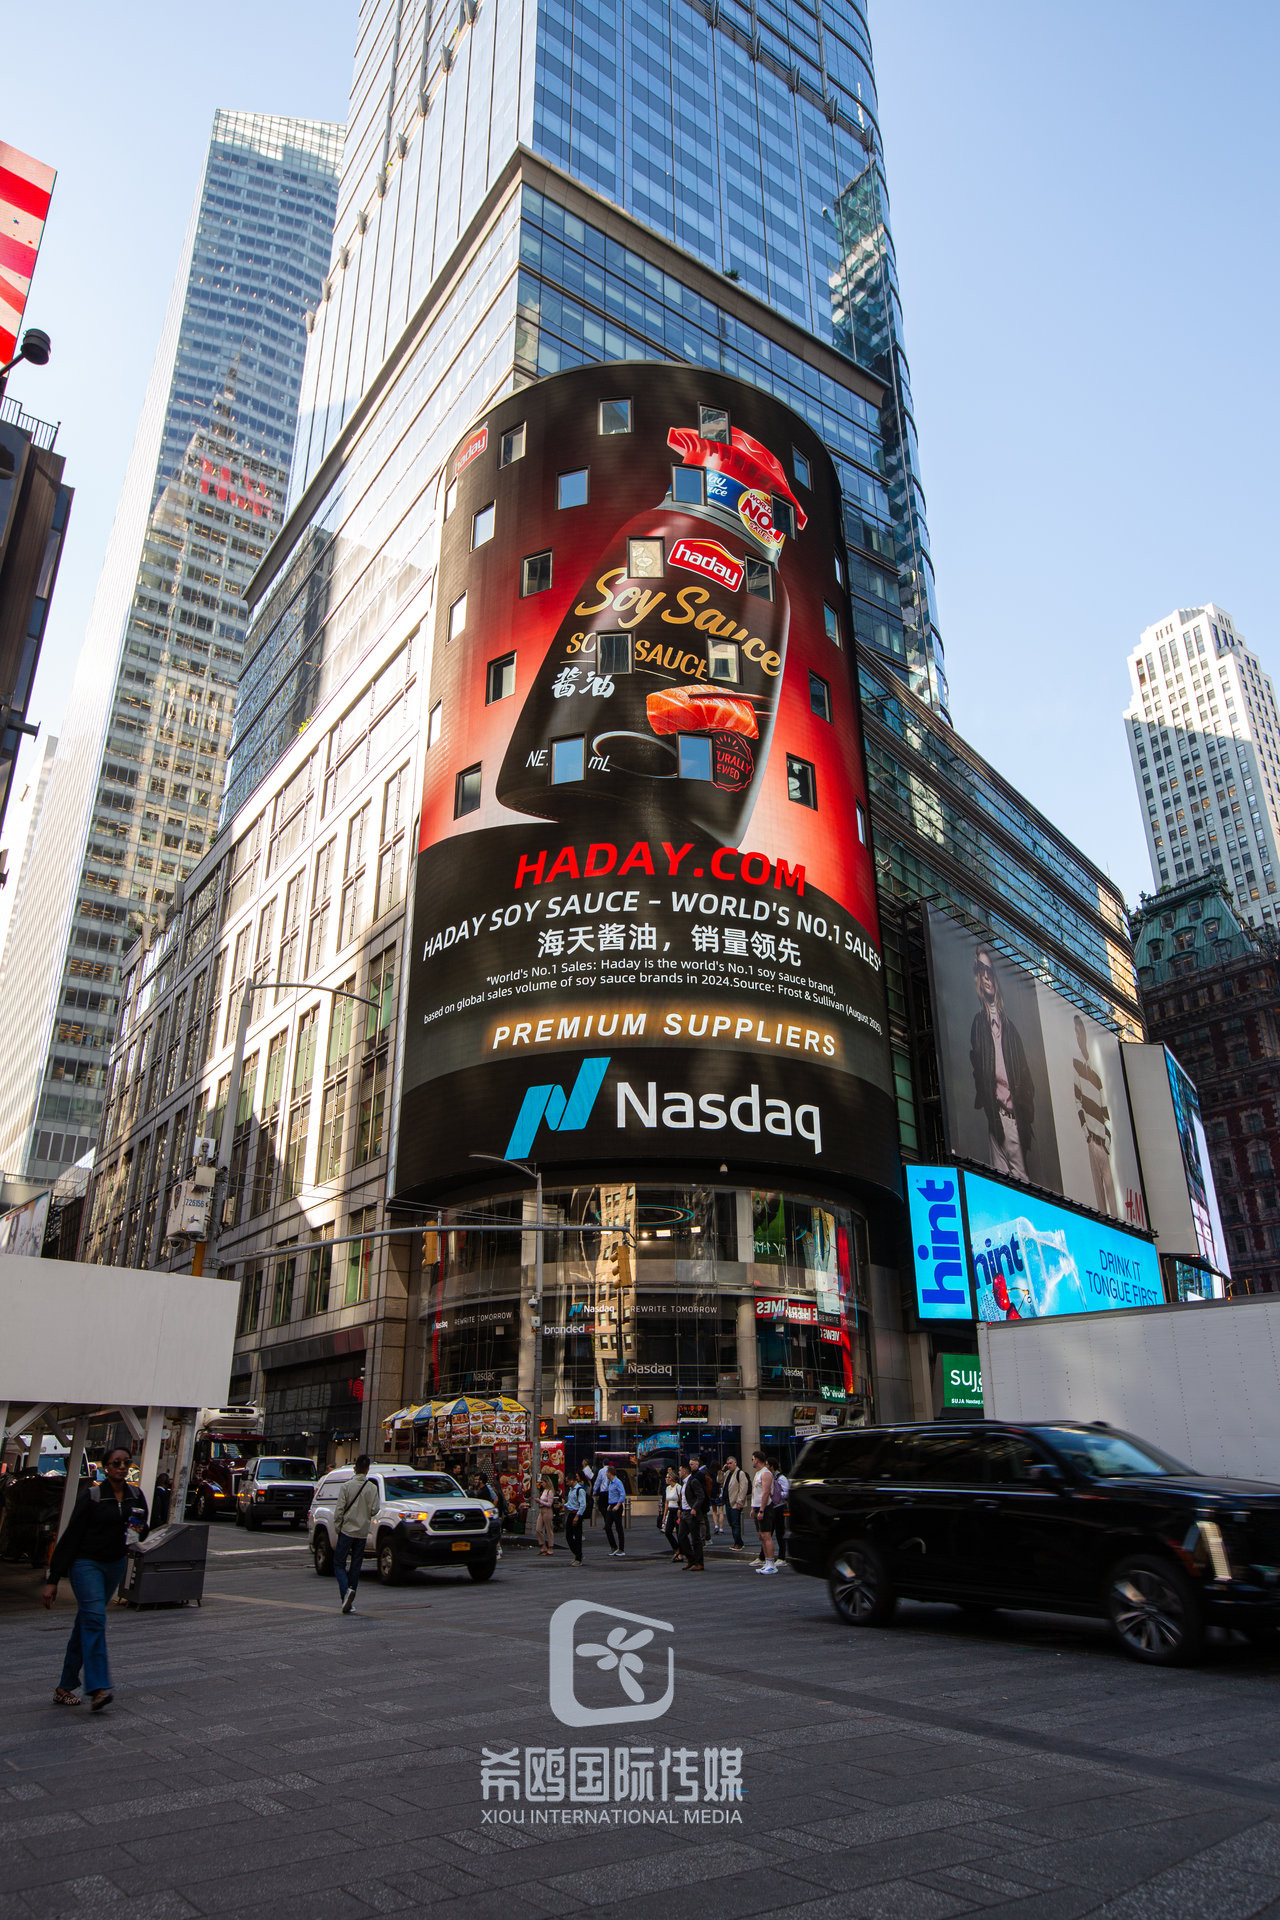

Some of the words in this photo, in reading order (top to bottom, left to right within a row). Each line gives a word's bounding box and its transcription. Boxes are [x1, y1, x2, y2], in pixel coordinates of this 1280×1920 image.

[454, 436, 485, 475] haday
[749, 492, 772, 514] WORLD
[748, 521, 772, 544] SALES
[676, 544, 738, 586] haday
[574, 567, 666, 628] Soy
[661, 586, 781, 676] Sauce
[566, 632, 596, 654] SO
[635, 640, 708, 682] SAUCE
[526, 750, 548, 768] NE
[588, 755, 611, 773] mL
[716, 750, 751, 774] URALLY
[716, 764, 740, 780] EWED
[514, 842, 806, 896] HADAY.COM
[422, 914, 486, 962] HADAY
[489, 900, 541, 932] SOY
[545, 890, 640, 919] SAUCE
[671, 891, 790, 927] WORLD'S
[796, 911, 841, 945] NO.1
[537, 922, 802, 967] 海天酱油，销量领先
[532, 964, 557, 978] No.1
[561, 960, 597, 974] Sales:
[601, 958, 640, 972] Haday
[644, 958, 654, 969] is
[658, 958, 678, 969] the
[680, 959, 725, 972] world's
[728, 962, 754, 976] No.1
[758, 968, 776, 980] soy
[778, 972, 806, 986] sauce
[808, 978, 836, 996] brand,
[424, 1006, 444, 1024] based
[444, 1003, 455, 1014] on
[456, 992, 485, 1012] global
[487, 986, 513, 1000] sales
[514, 979, 557, 994] volume
[560, 976, 572, 987] of
[576, 975, 597, 987] soy
[600, 974, 636, 984] sauce
[640, 972, 683, 984] brands
[686, 973, 698, 984] in
[701, 974, 776, 993] 2024.Source:
[778, 984, 803, 999] Frost
[804, 991, 812, 1001] &
[812, 992, 844, 1012] Sullivan
[846, 1004, 869, 1025] (August
[492, 1013, 646, 1050] PREMIUM
[664, 1014, 835, 1056] SUPPLIERS
[616, 1082, 823, 1155] Nasdaq
[1125, 1188, 1144, 1226] H&M
[917, 1180, 966, 1304] hint
[973, 1232, 1024, 1289] hint
[1100, 1249, 1132, 1275] DRINK
[1131, 1262, 1140, 1282] IT
[1086, 1270, 1132, 1304] TONGUE
[1133, 1284, 1158, 1306] FIRST
[454, 1316, 476, 1326] REWRITE
[478, 1312, 512, 1322] TOMORROW
[584, 1304, 614, 1314] Nasdaq
[671, 1306, 718, 1314] TOMORROW
[628, 1363, 672, 1376] Nasdaq
